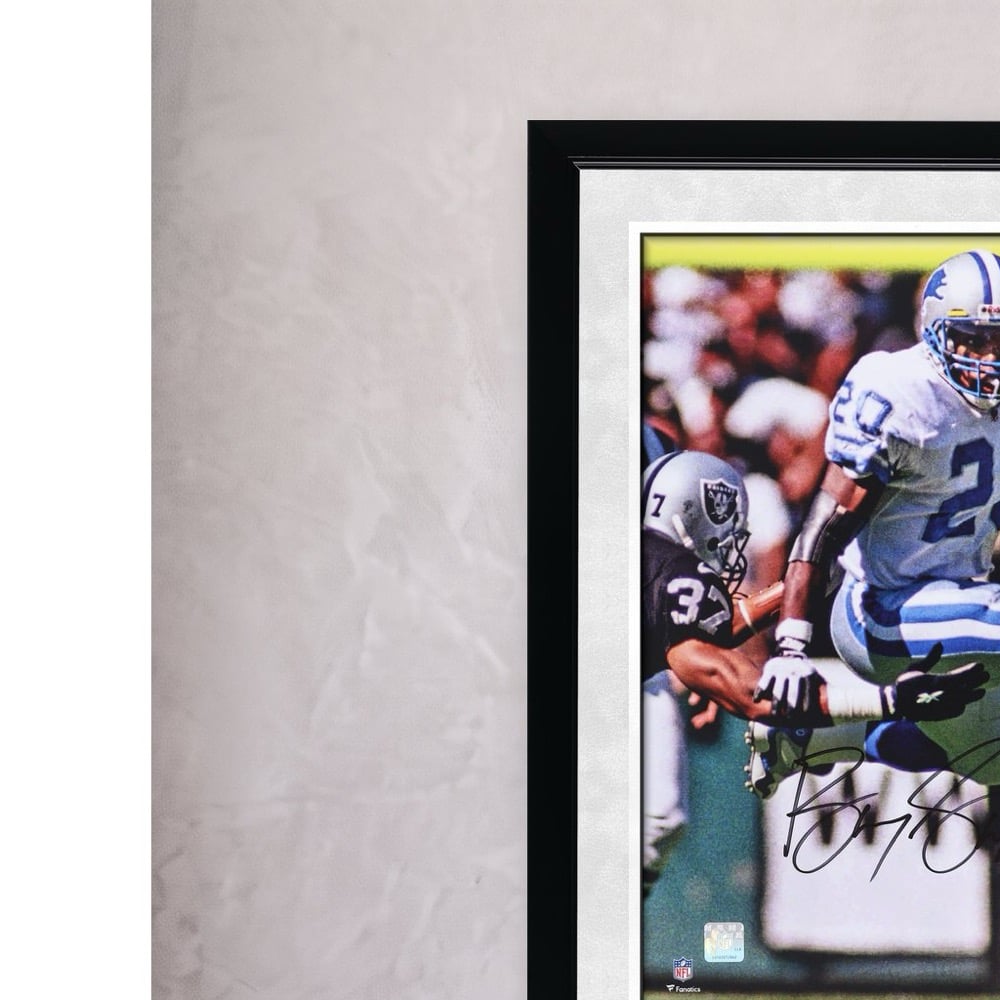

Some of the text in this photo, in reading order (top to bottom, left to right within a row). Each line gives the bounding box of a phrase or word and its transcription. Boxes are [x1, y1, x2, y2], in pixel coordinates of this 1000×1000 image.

[834, 381, 893, 436] 20
[651, 493, 666, 518] 7
[667, 577, 731, 635] 37
[676, 967, 691, 979] NFL
[675, 985, 701, 993] Fanatics
